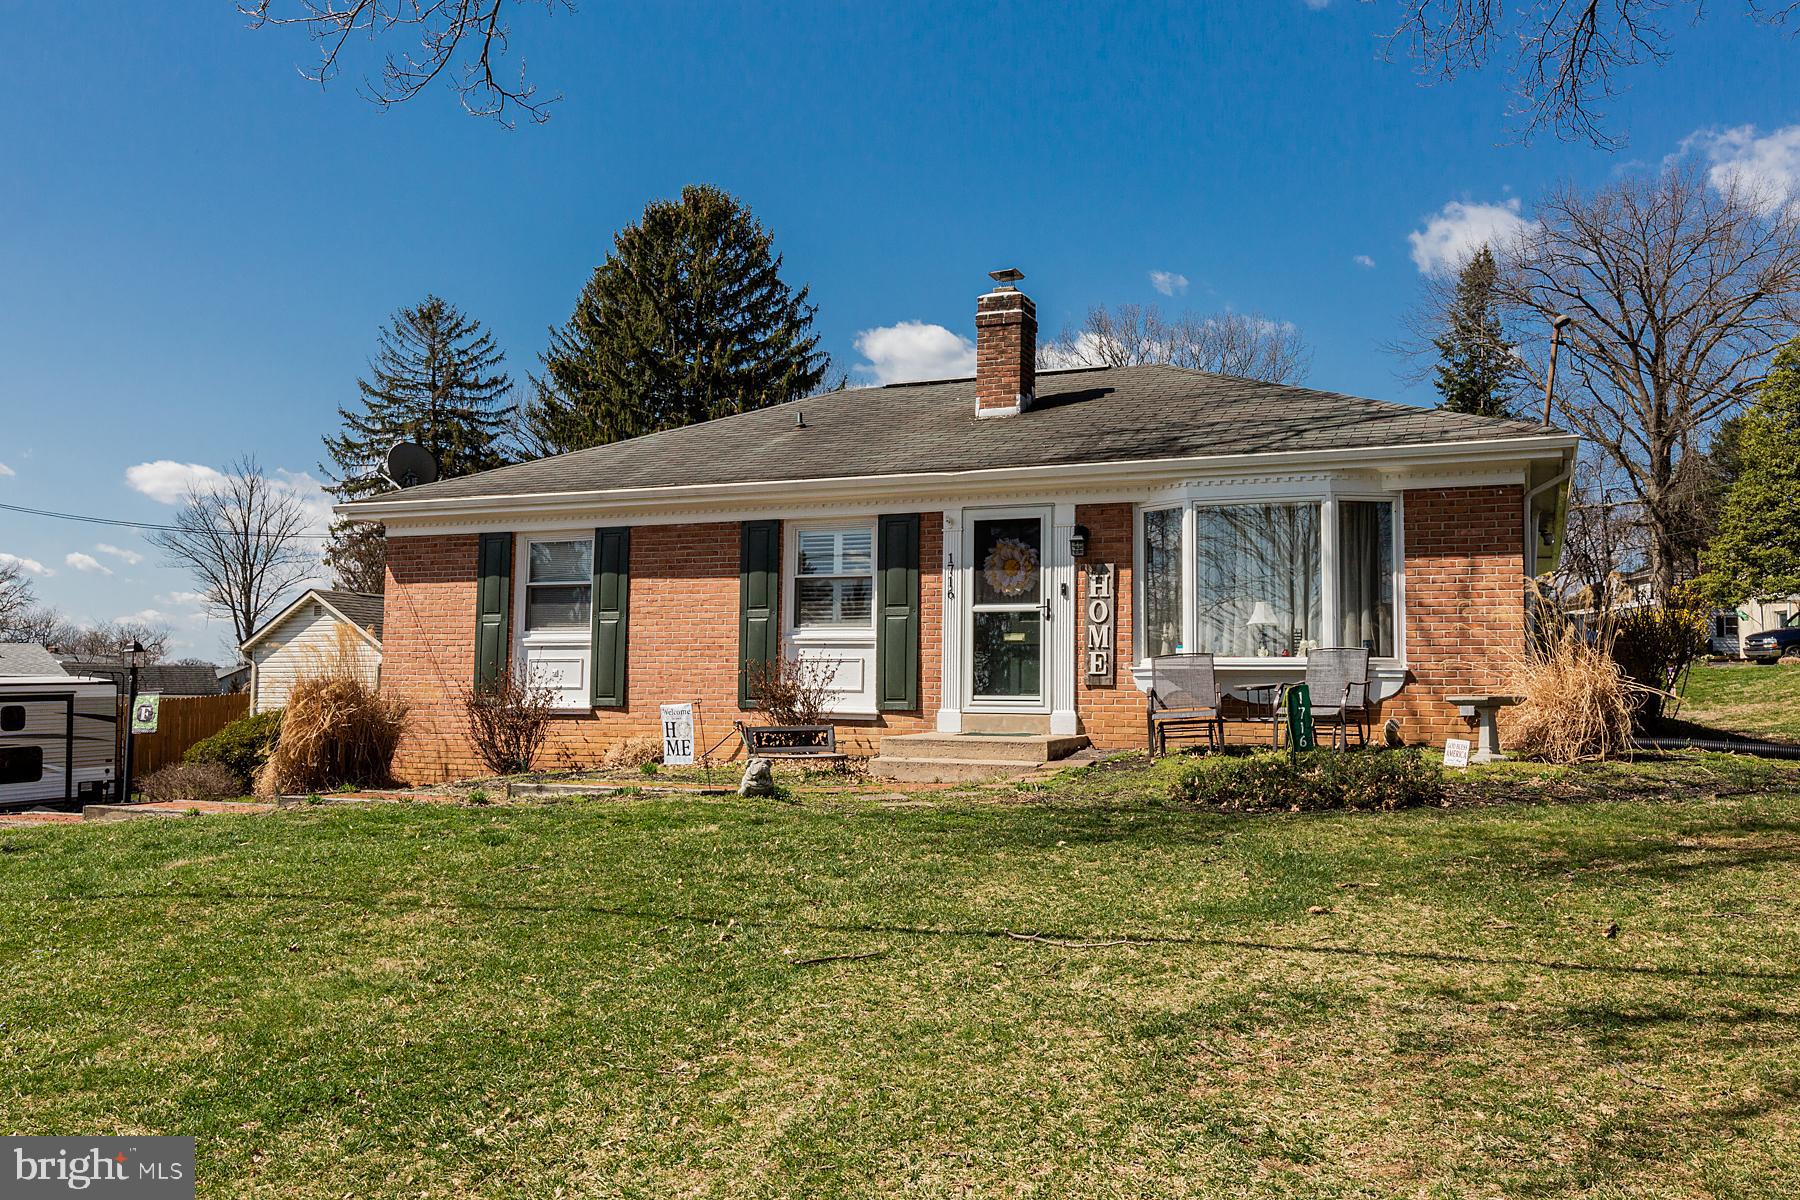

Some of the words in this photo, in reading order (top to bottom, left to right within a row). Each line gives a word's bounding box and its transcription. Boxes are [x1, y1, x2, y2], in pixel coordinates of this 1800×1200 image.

[1088, 574, 1110, 675] HOME
[140, 706, 151, 721] F
[662, 708, 691, 716] Welcome
[1298, 691, 1307, 748] 1716
[1446, 749, 1467, 759] AMERICA
